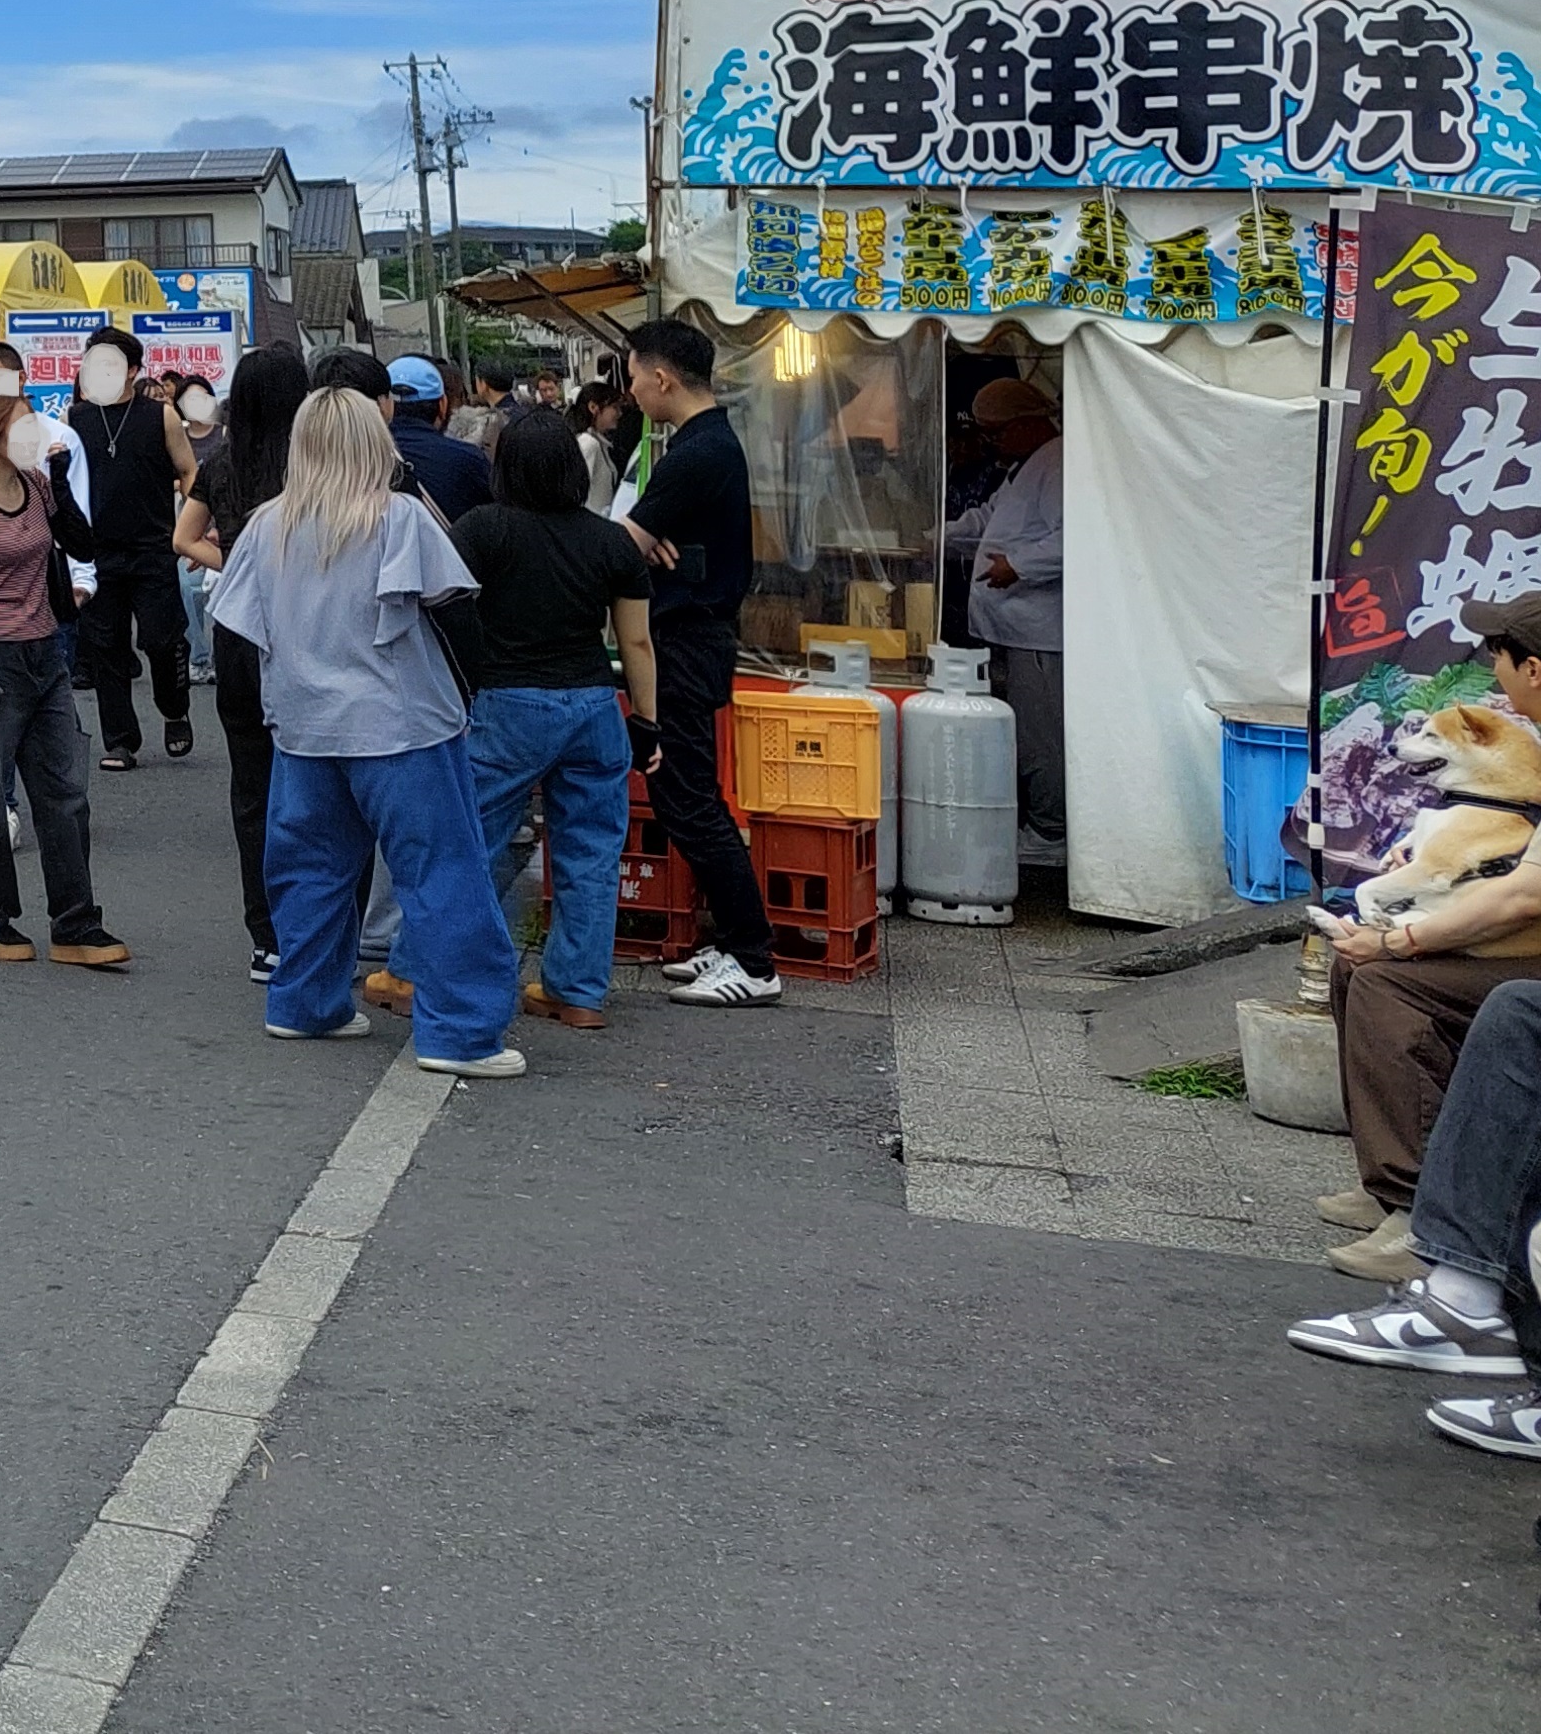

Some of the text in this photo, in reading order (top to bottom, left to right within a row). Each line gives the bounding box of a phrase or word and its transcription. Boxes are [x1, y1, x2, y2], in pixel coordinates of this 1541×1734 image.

[900, 283, 971, 310] 500円
[1060, 279, 1128, 315] 800円
[1146, 298, 1218, 320] 700円
[1356, 231, 1478, 557] 今が旬!
